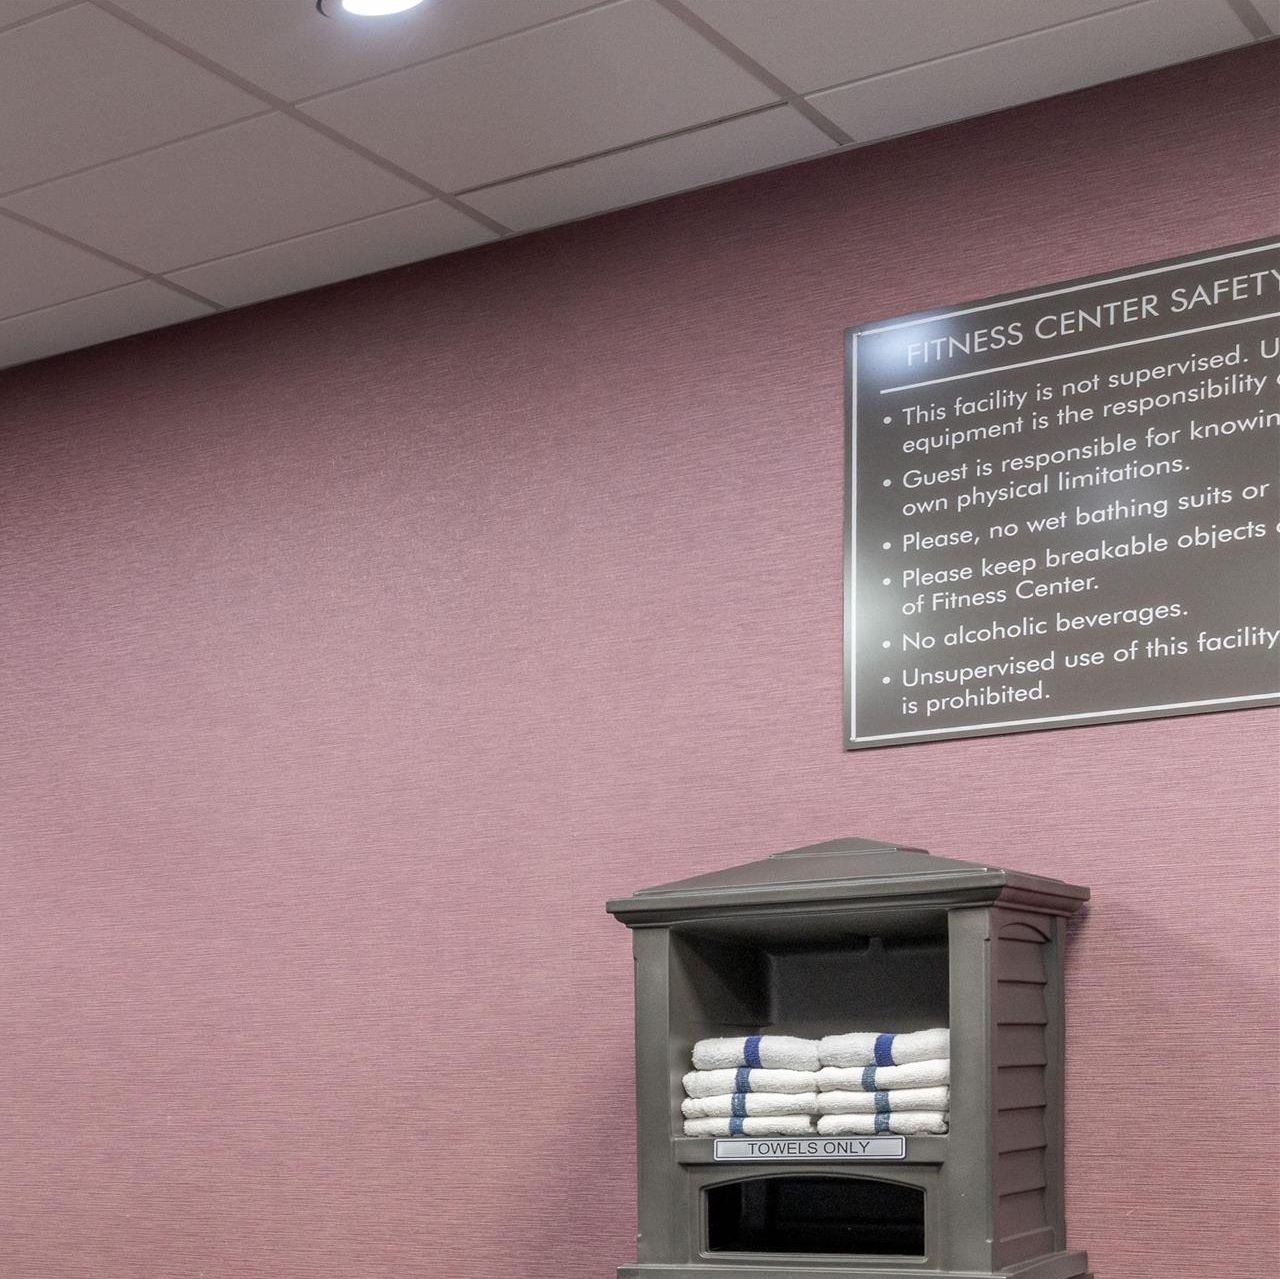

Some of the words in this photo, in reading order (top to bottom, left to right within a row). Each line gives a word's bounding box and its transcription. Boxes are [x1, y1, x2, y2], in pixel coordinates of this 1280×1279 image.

[906, 323, 1023, 367] FITNESS
[1035, 295, 1159, 338] CENTER
[902, 404, 946, 425] This
[954, 390, 1028, 416] facility
[1037, 383, 1052, 401] is
[1063, 374, 1100, 396] not
[1109, 344, 1248, 388] supervised.
[903, 417, 1024, 454] equipment
[1032, 412, 1048, 430] is
[1057, 405, 1094, 425] the
[1104, 374, 1267, 417] responsibility
[903, 464, 968, 488] Guest
[977, 459, 992, 476] is
[1002, 434, 1136, 472] responsible
[1145, 428, 1181, 448] for
[903, 498, 947, 516] own
[958, 474, 1048, 512] physical
[1059, 459, 1190, 490] limitations.
[904, 531, 979, 552] Please,
[990, 524, 1018, 538] no
[1026, 512, 1067, 532] wet
[1077, 499, 1168, 525] bathing
[1178, 487, 1232, 509] suits
[1242, 484, 1270, 499] or
[904, 567, 972, 588] Please
[982, 558, 1036, 576] keep
[1046, 534, 1168, 567] breakable
[1178, 522, 1266, 548] objects
[903, 594, 924, 614] of
[933, 590, 1006, 610] Fitness
[1016, 577, 1098, 598] Center.
[903, 651, 1054, 686] Unsupervised
[1066, 652, 1104, 668] use
[1114, 640, 1138, 662] of
[1146, 637, 1188, 658] this
[1197, 626, 1280, 652] facility
[904, 632, 935, 650] No
[944, 617, 1047, 645] alcoholic
[1057, 604, 1188, 632] beverages.
[902, 697, 917, 714] is
[927, 680, 1050, 716] prohibited.
[748, 1143, 818, 1155] TOWELS
[824, 1140, 870, 1155] ONLY
